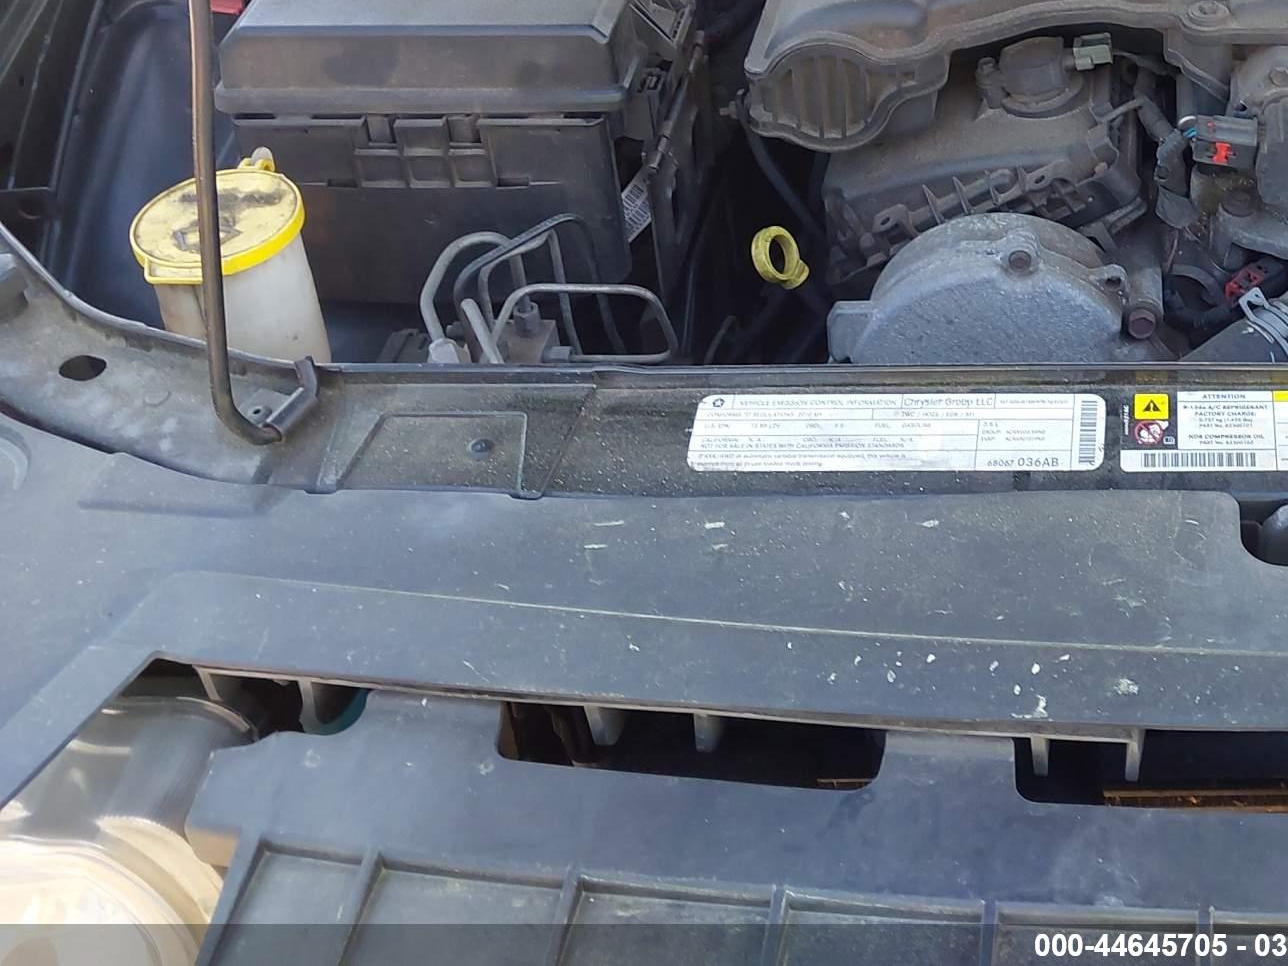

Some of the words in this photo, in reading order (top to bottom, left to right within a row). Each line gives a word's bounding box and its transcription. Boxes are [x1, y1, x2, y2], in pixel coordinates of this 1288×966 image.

[903, 397, 944, 408] Chrysler
[945, 397, 973, 408] Group
[976, 397, 993, 406] LLC
[1017, 457, 1059, 467] 036AB
